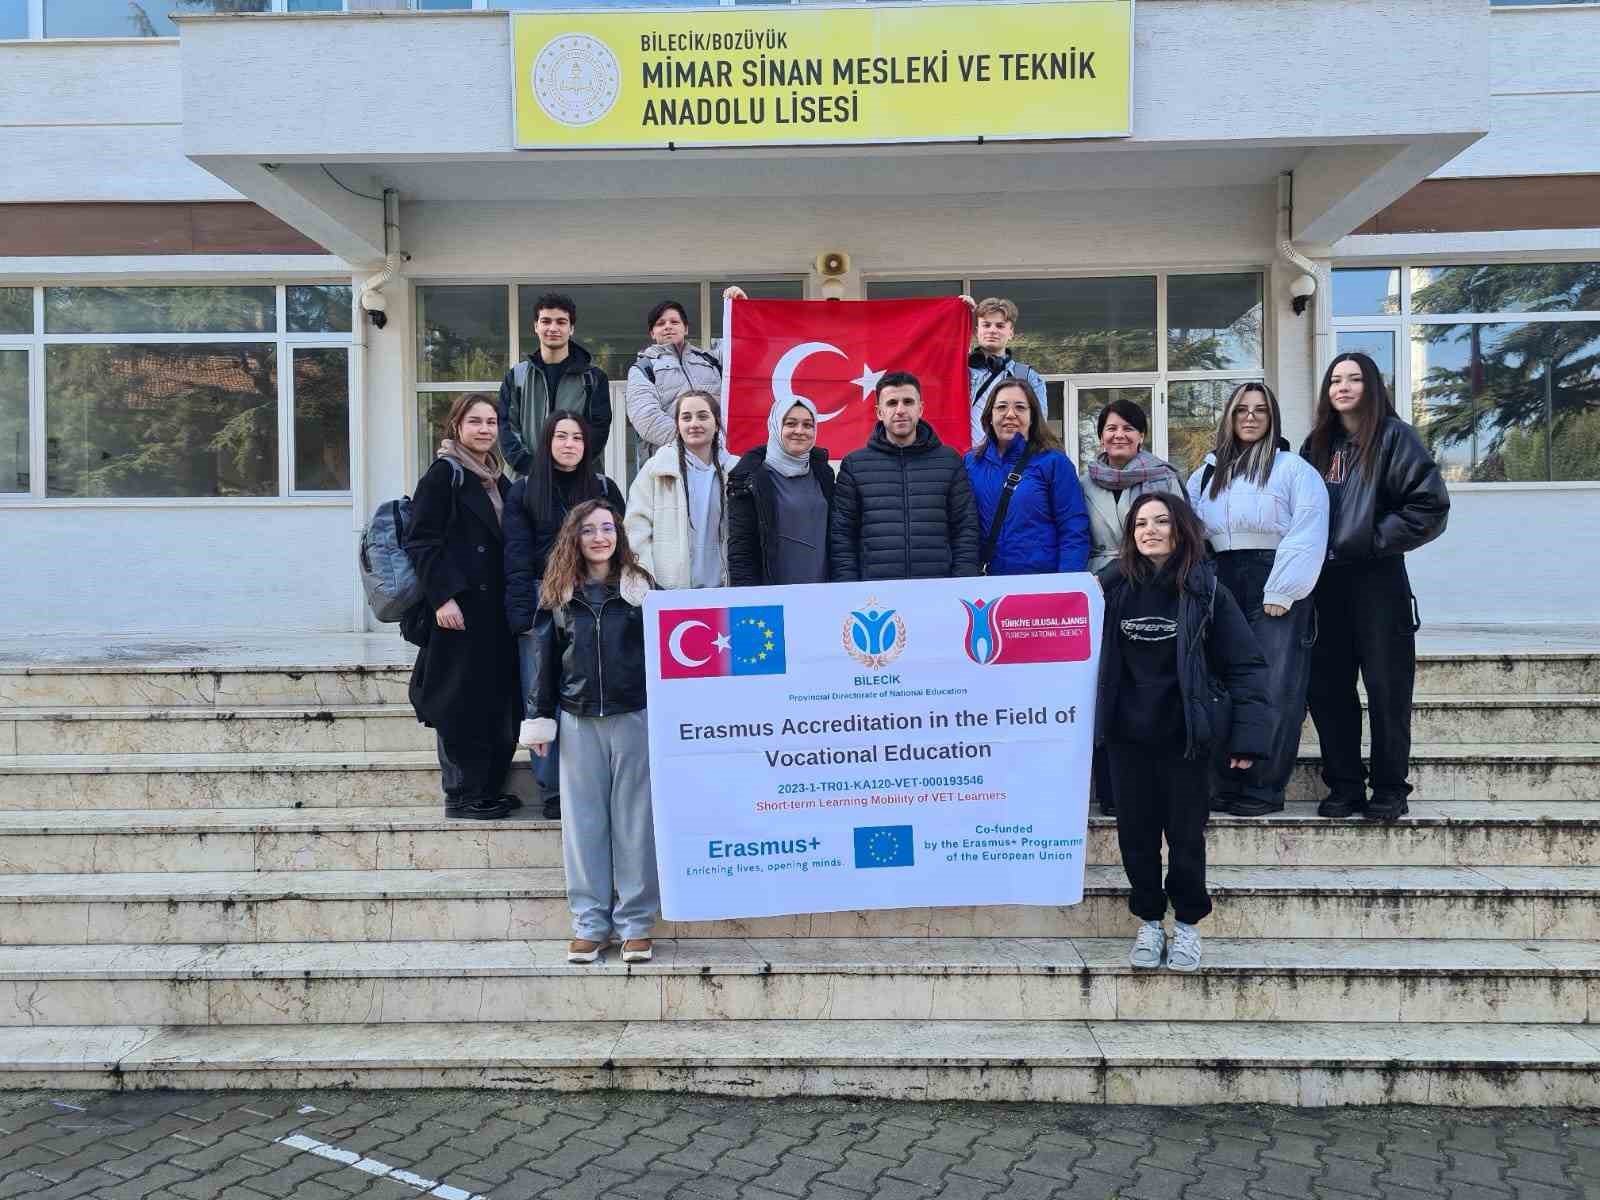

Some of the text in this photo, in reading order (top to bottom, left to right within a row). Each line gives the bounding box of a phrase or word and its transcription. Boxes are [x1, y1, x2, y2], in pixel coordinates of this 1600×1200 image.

[640, 28, 788, 52] BİLECİK/BOZÜYÜK
[642, 55, 733, 88] MİMAR
[742, 53, 823, 87] SİNAN
[833, 49, 948, 86] MESLEKİ
[958, 54, 991, 82] VE
[999, 46, 1097, 81] TEKNİK
[642, 89, 858, 126] ANADOLU LİSESİ
[1001, 616, 1088, 628] TÜRKİYE ULUSAL AJANSI
[854, 673, 901, 686] BİLECİK
[789, 687, 968, 702] Provincial Directorate of National Education
[679, 705, 1078, 741] Erasmus Accreditation in the Field of
[765, 741, 992, 768] Vocational Education
[778, 775, 985, 795] 2023-1-TR01-KA120-VET-000193546
[757, 790, 1007, 811] Short-term Learning Mobility of VET Learners
[975, 824, 1033, 835] Co-funded
[708, 836, 821, 859] Erasmus+
[924, 840, 938, 851] by
[941, 839, 959, 849] the
[962, 838, 1018, 849] Erasmus+
[946, 851, 1073, 862] of the European Union
[687, 863, 734, 877] Enriching
[737, 863, 764, 873] lives,
[767, 860, 809, 872] opening
